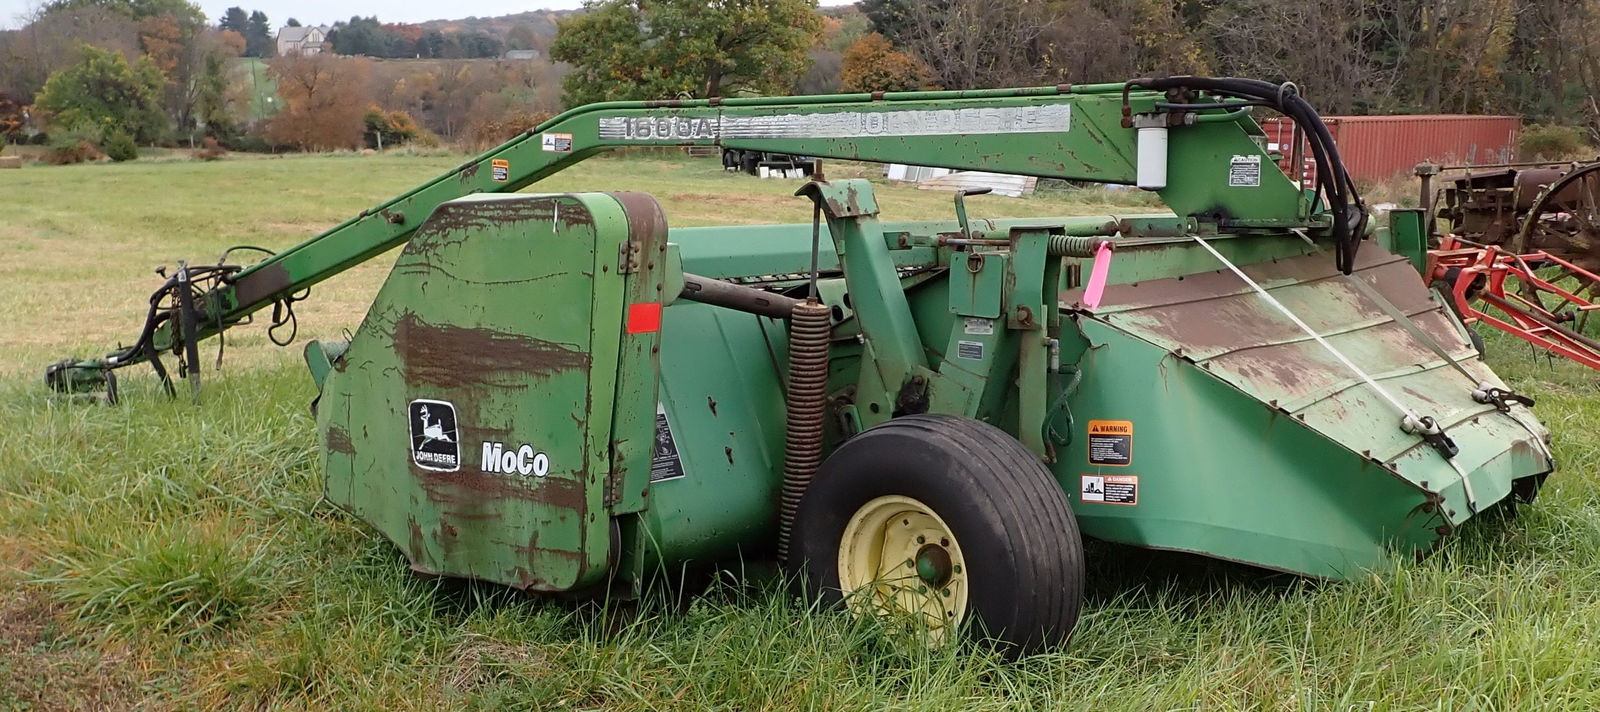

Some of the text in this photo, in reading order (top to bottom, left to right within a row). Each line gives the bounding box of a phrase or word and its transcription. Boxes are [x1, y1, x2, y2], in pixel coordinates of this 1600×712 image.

[624, 117, 714, 139] 1600A
[1100, 425, 1128, 433] WARNING
[415, 450, 456, 464] JOHN DEERE
[481, 442, 549, 477] MoCo
